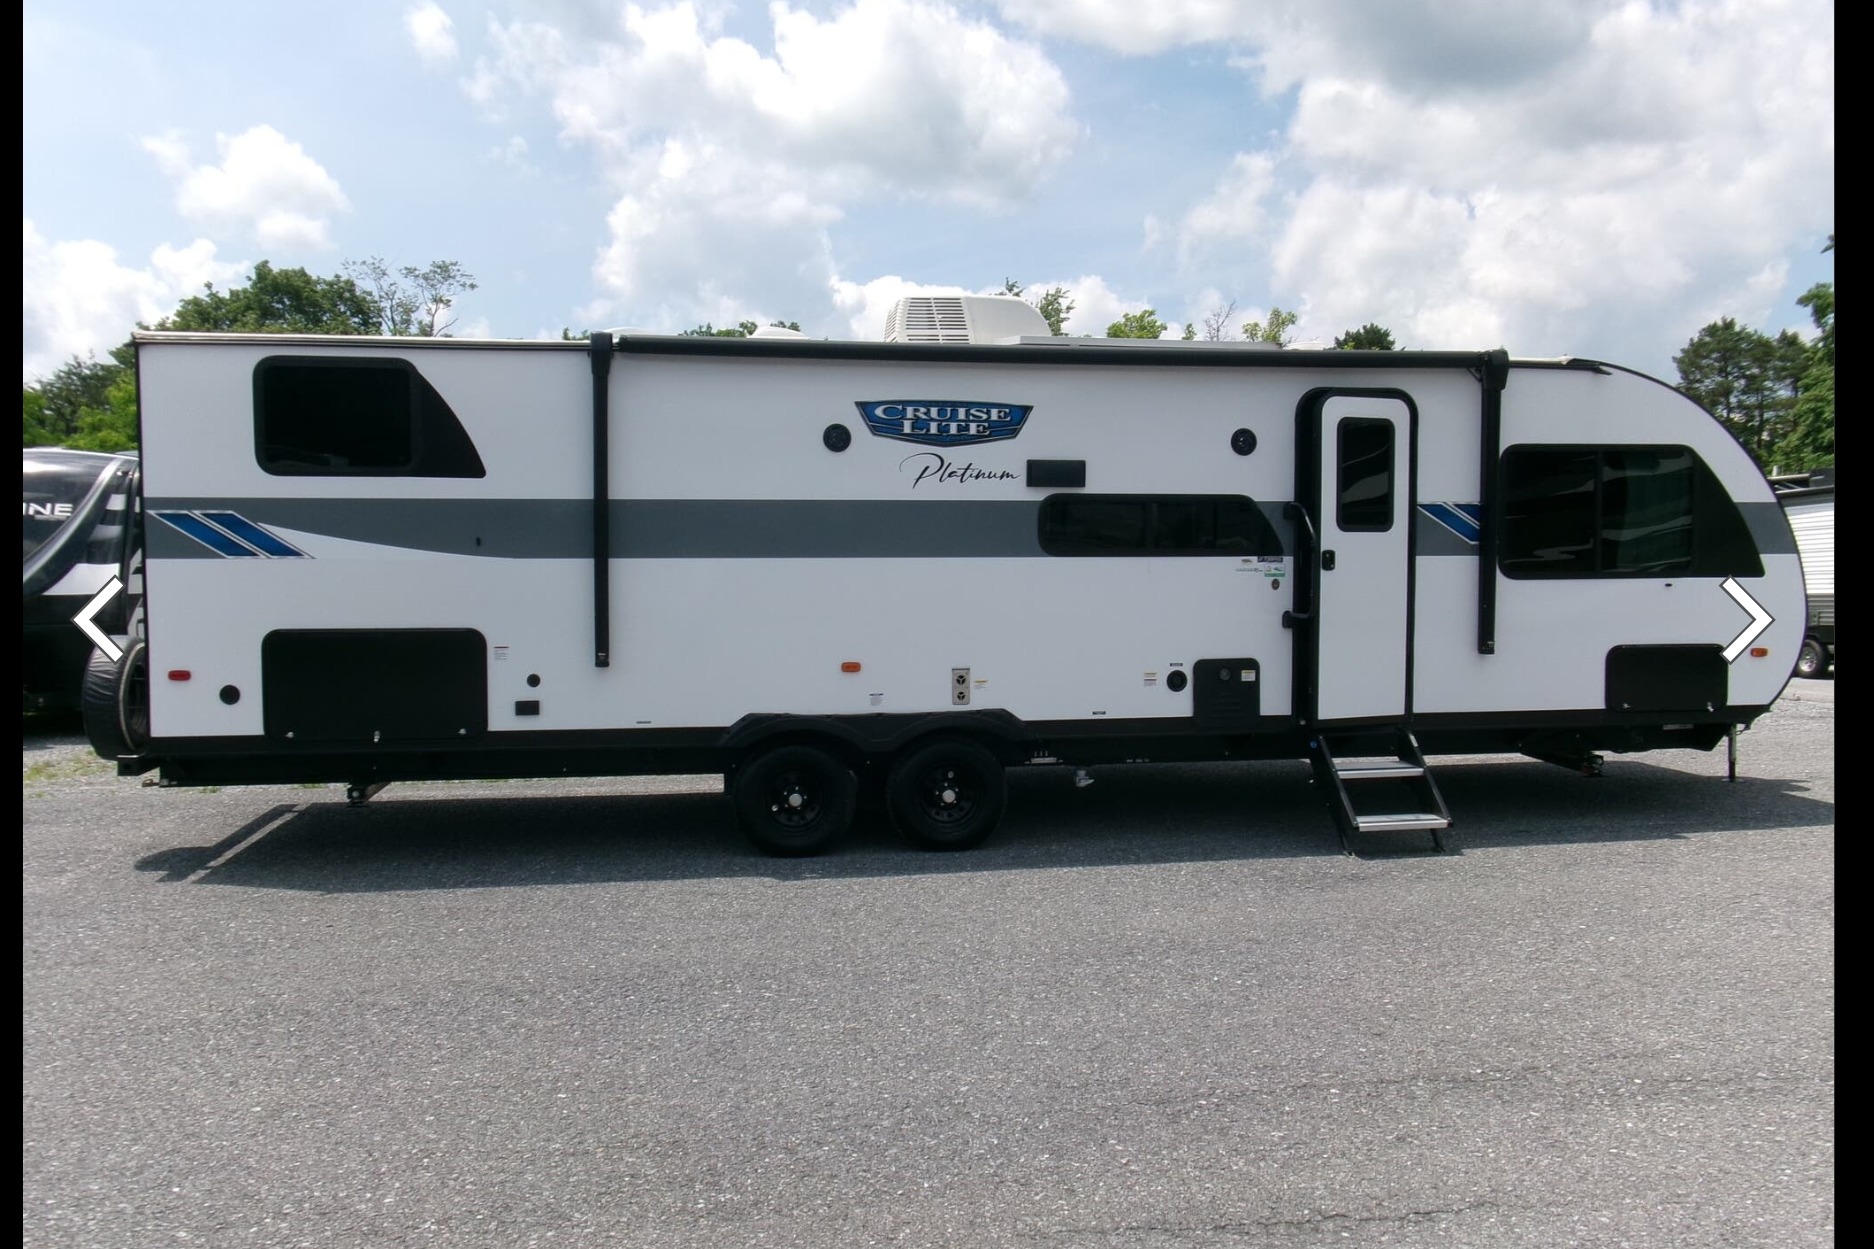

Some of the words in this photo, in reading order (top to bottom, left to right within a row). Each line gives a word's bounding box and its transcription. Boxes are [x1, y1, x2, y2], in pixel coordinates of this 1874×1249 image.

[875, 404, 1011, 421] CRUISE
[902, 420, 991, 436] LITE
[899, 452, 1020, 490] Platinum
